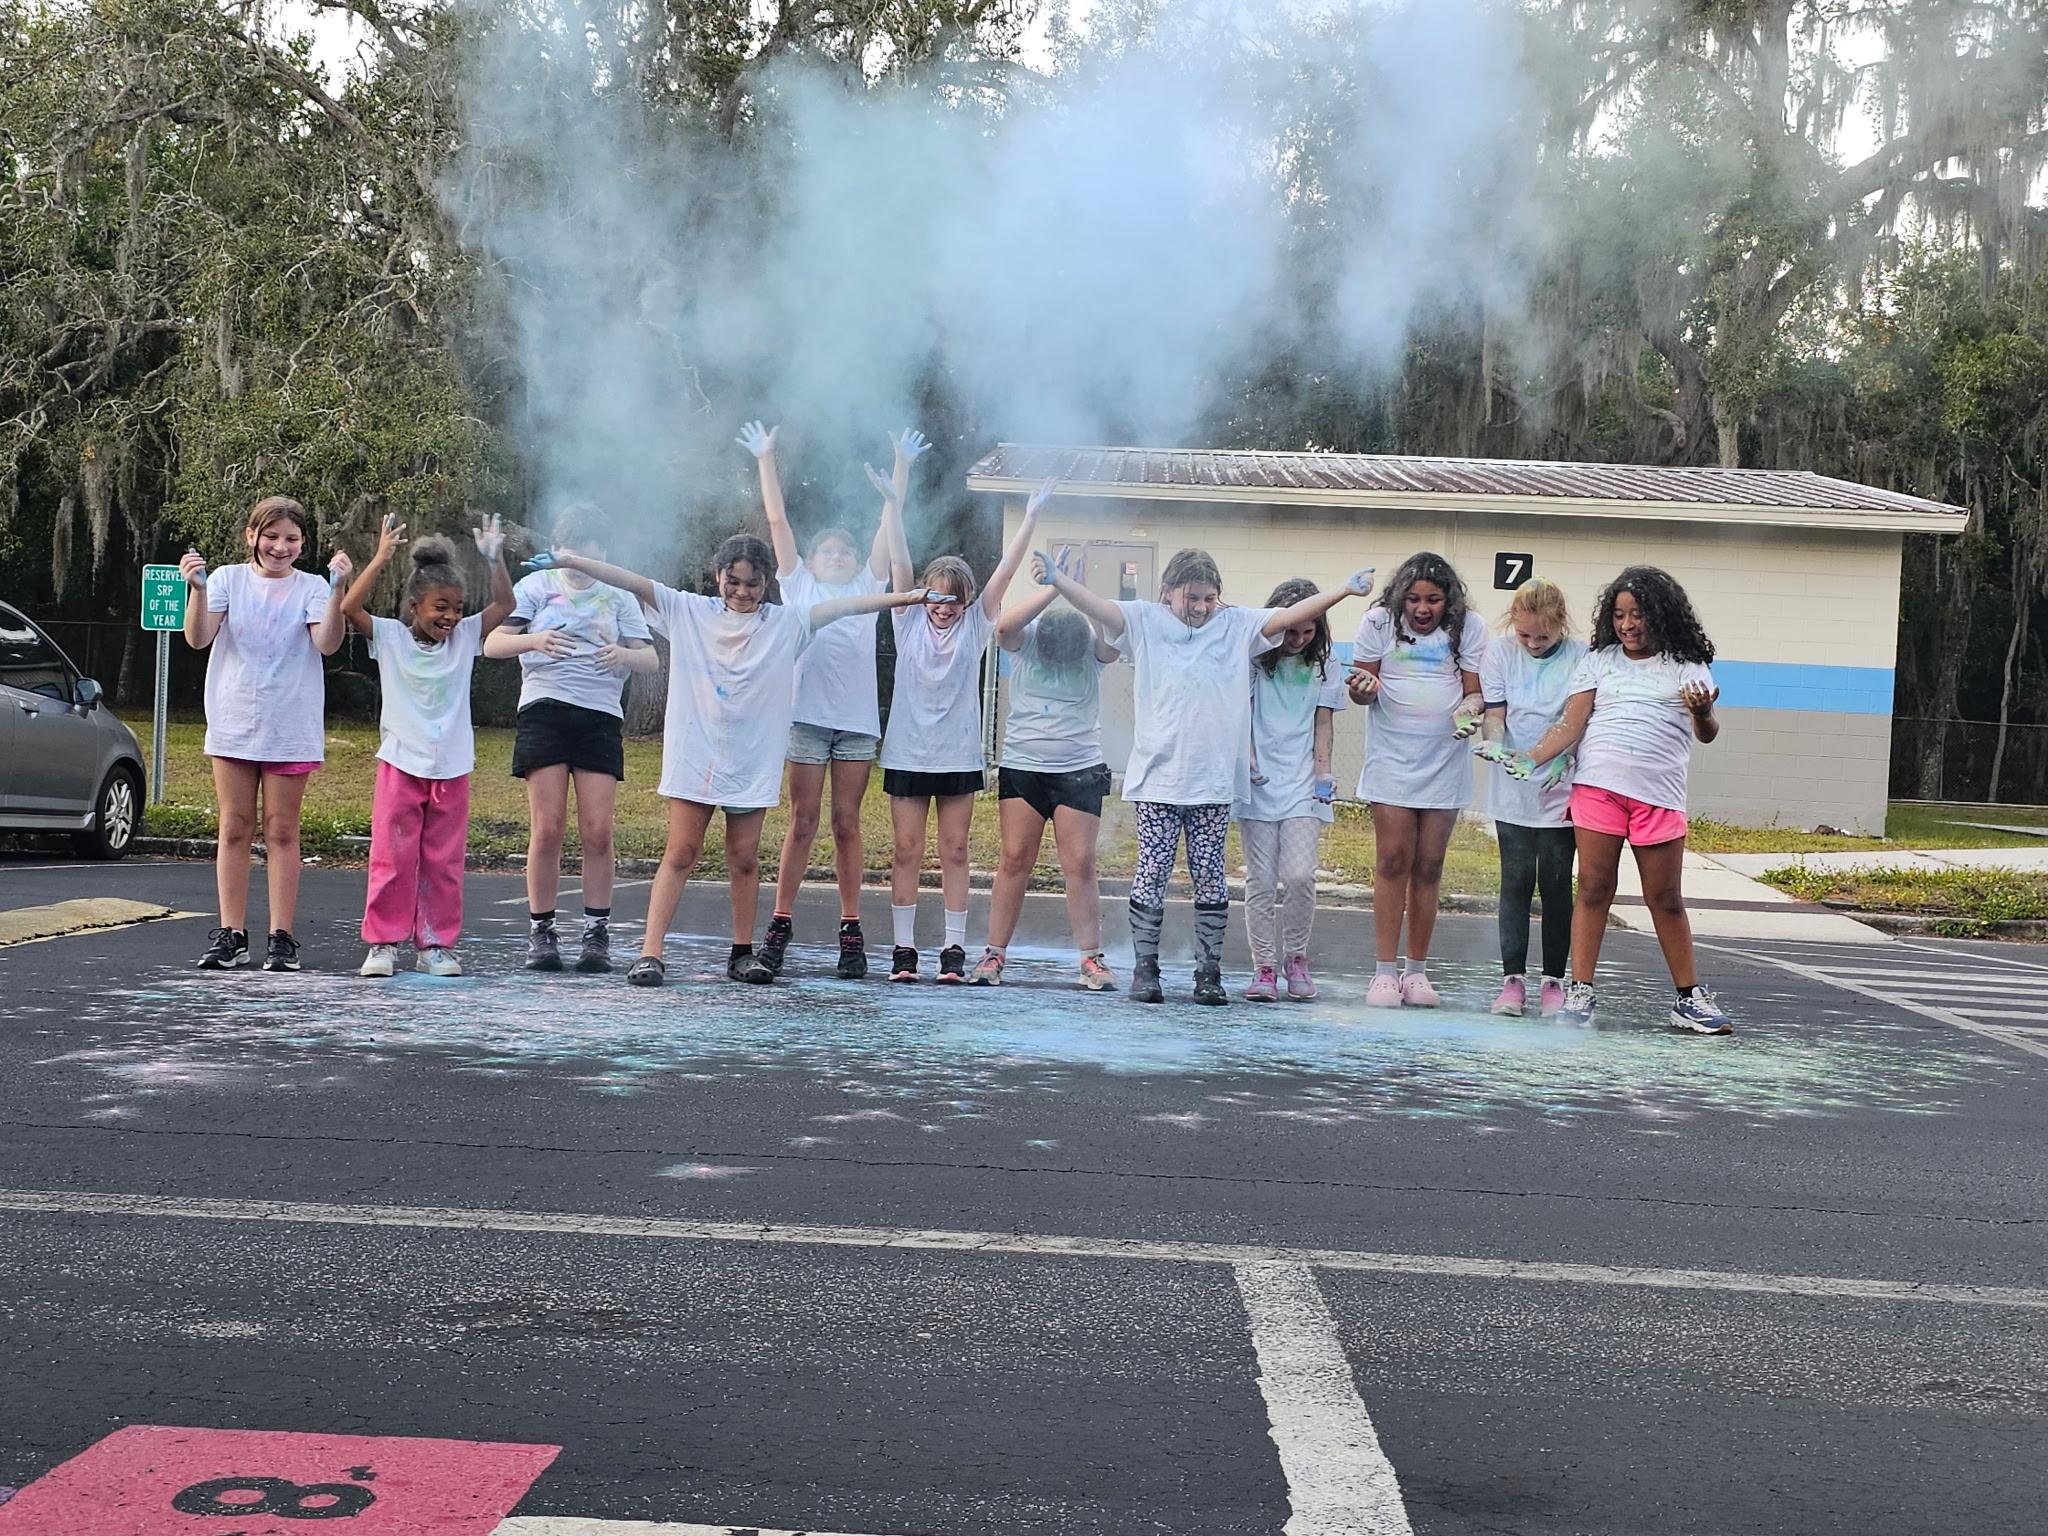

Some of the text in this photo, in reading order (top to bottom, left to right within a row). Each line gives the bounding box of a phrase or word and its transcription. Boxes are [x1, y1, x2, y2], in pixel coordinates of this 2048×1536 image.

[1505, 559, 1524, 584] 7
[157, 584, 173, 596] SRP
[149, 599, 179, 611] OF THE
[152, 614, 176, 626] YEAR
[171, 1476, 377, 1520] 8
